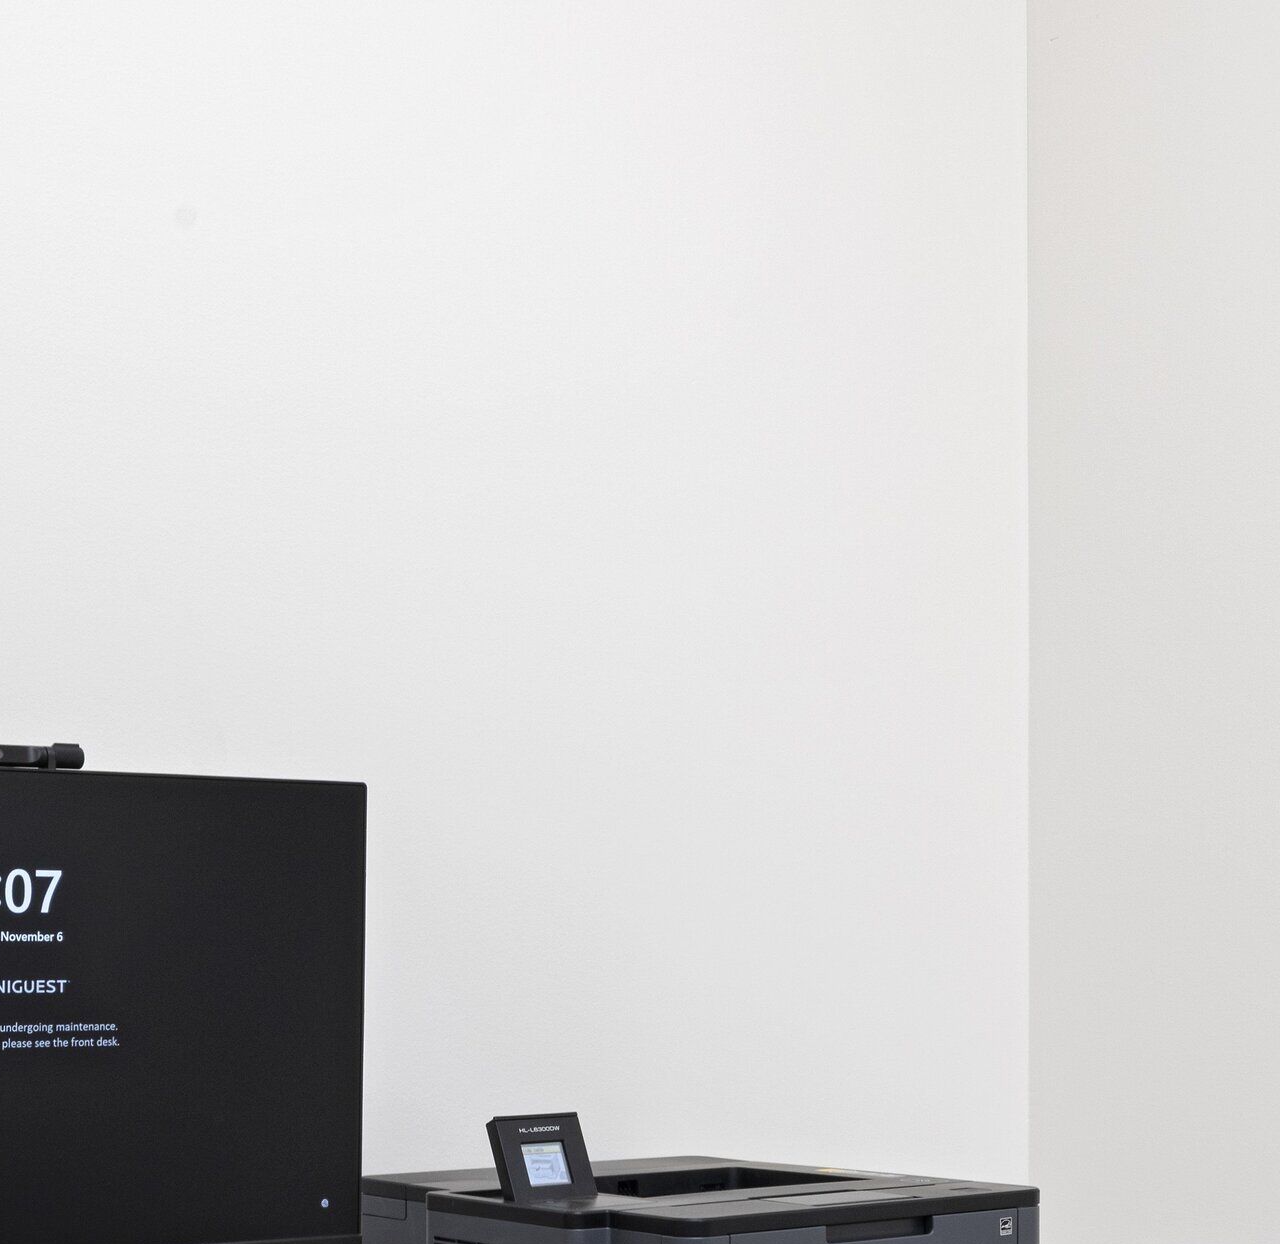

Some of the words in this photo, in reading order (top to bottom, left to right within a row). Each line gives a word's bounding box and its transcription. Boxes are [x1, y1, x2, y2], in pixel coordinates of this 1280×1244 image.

[0, 931, 54, 942] November
[56, 931, 63, 942] 6
[0, 1022, 54, 1034] undergoing
[55, 1021, 118, 1032] maintenance.
[2, 1038, 32, 1050] please
[34, 1040, 51, 1048] see
[53, 1037, 69, 1047] the
[71, 1036, 94, 1047] front
[96, 1036, 120, 1047] desk.
